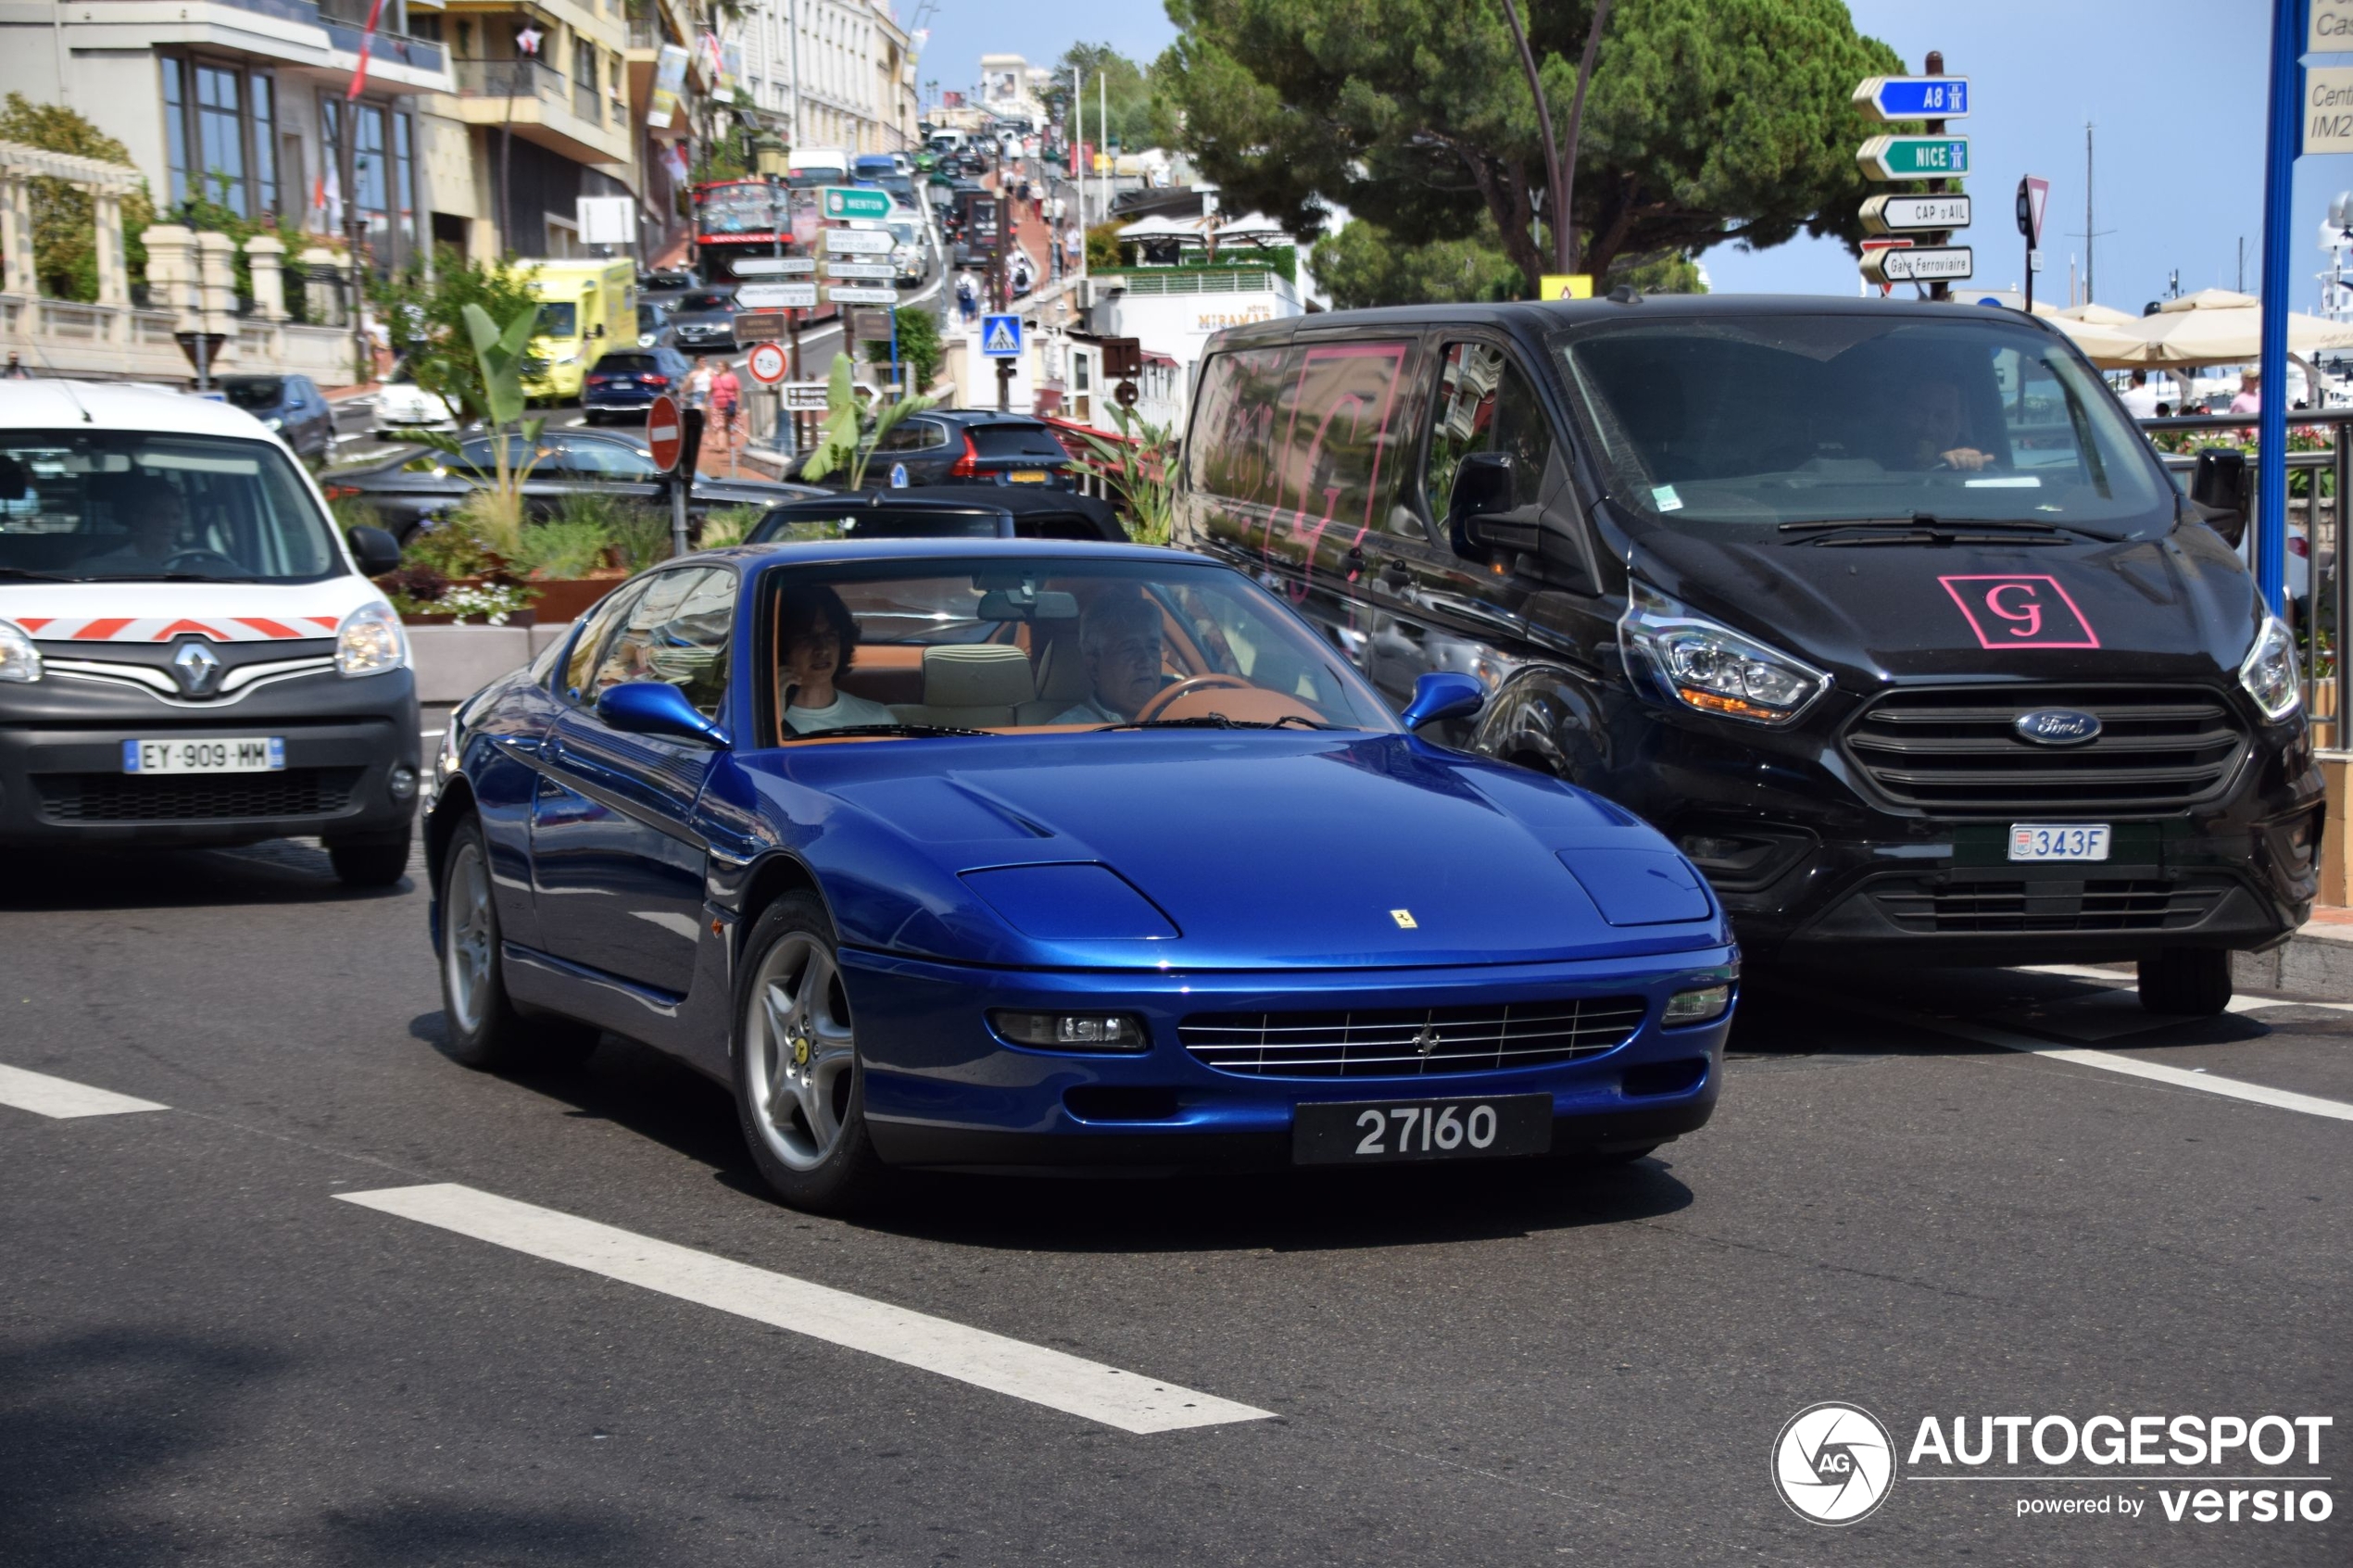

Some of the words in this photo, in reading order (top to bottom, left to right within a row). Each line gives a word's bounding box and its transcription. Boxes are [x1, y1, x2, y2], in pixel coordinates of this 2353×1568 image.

[1923, 86, 1944, 108] A8
[2312, 84, 2353, 107] Cent
[1916, 147, 1946, 167] NICE
[847, 199, 884, 210] MENTON
[1916, 206, 1935, 220] CAP
[782, 261, 812, 270] CASINO
[1891, 259, 1912, 272] Gare
[1916, 258, 1966, 271] Ferroviaire
[1986, 584, 2042, 637] G
[2038, 715, 2084, 734] Ford
[143, 744, 266, 769] EY-909-MM
[2035, 830, 2104, 856] 343F
[1355, 1105, 1497, 1154] 27160
